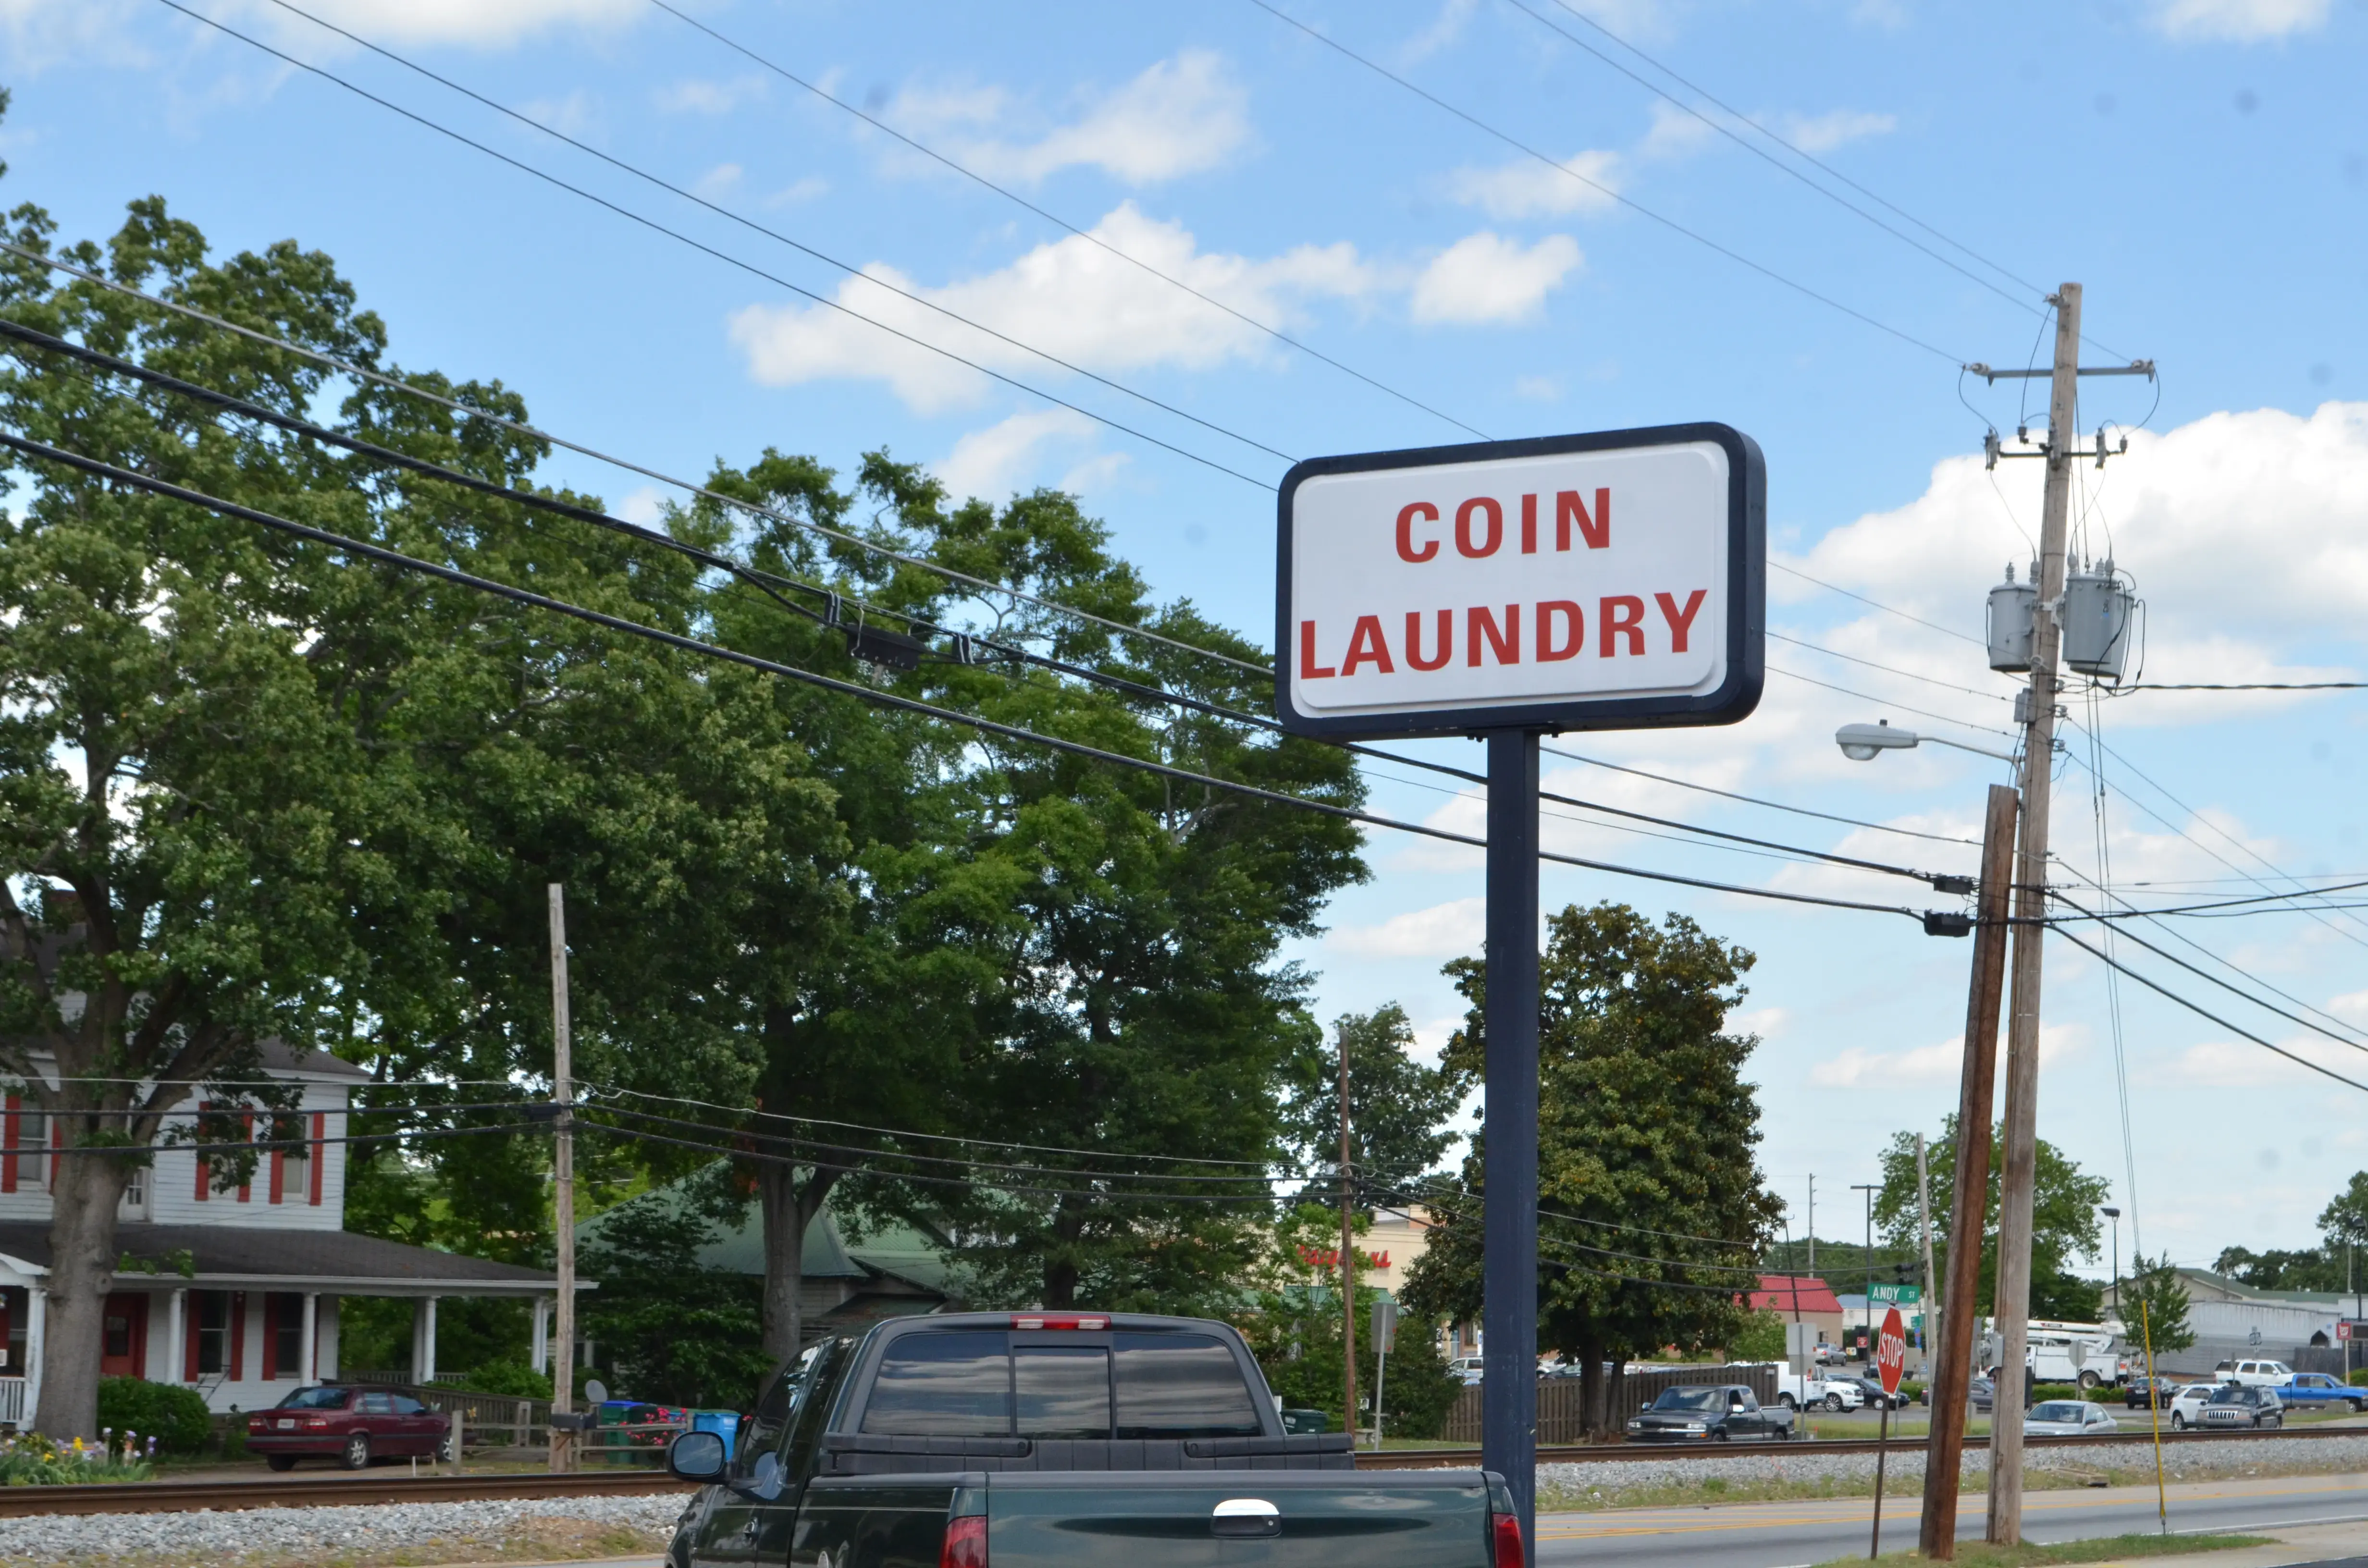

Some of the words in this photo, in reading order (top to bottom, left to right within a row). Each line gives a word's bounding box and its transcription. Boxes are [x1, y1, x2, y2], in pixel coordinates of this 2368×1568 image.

[1396, 487, 1610, 563] COIN
[1301, 589, 1707, 679] LAUNDRY
[1872, 1286, 1900, 1300] ANDY
[1880, 1332, 1903, 1368] STOP
